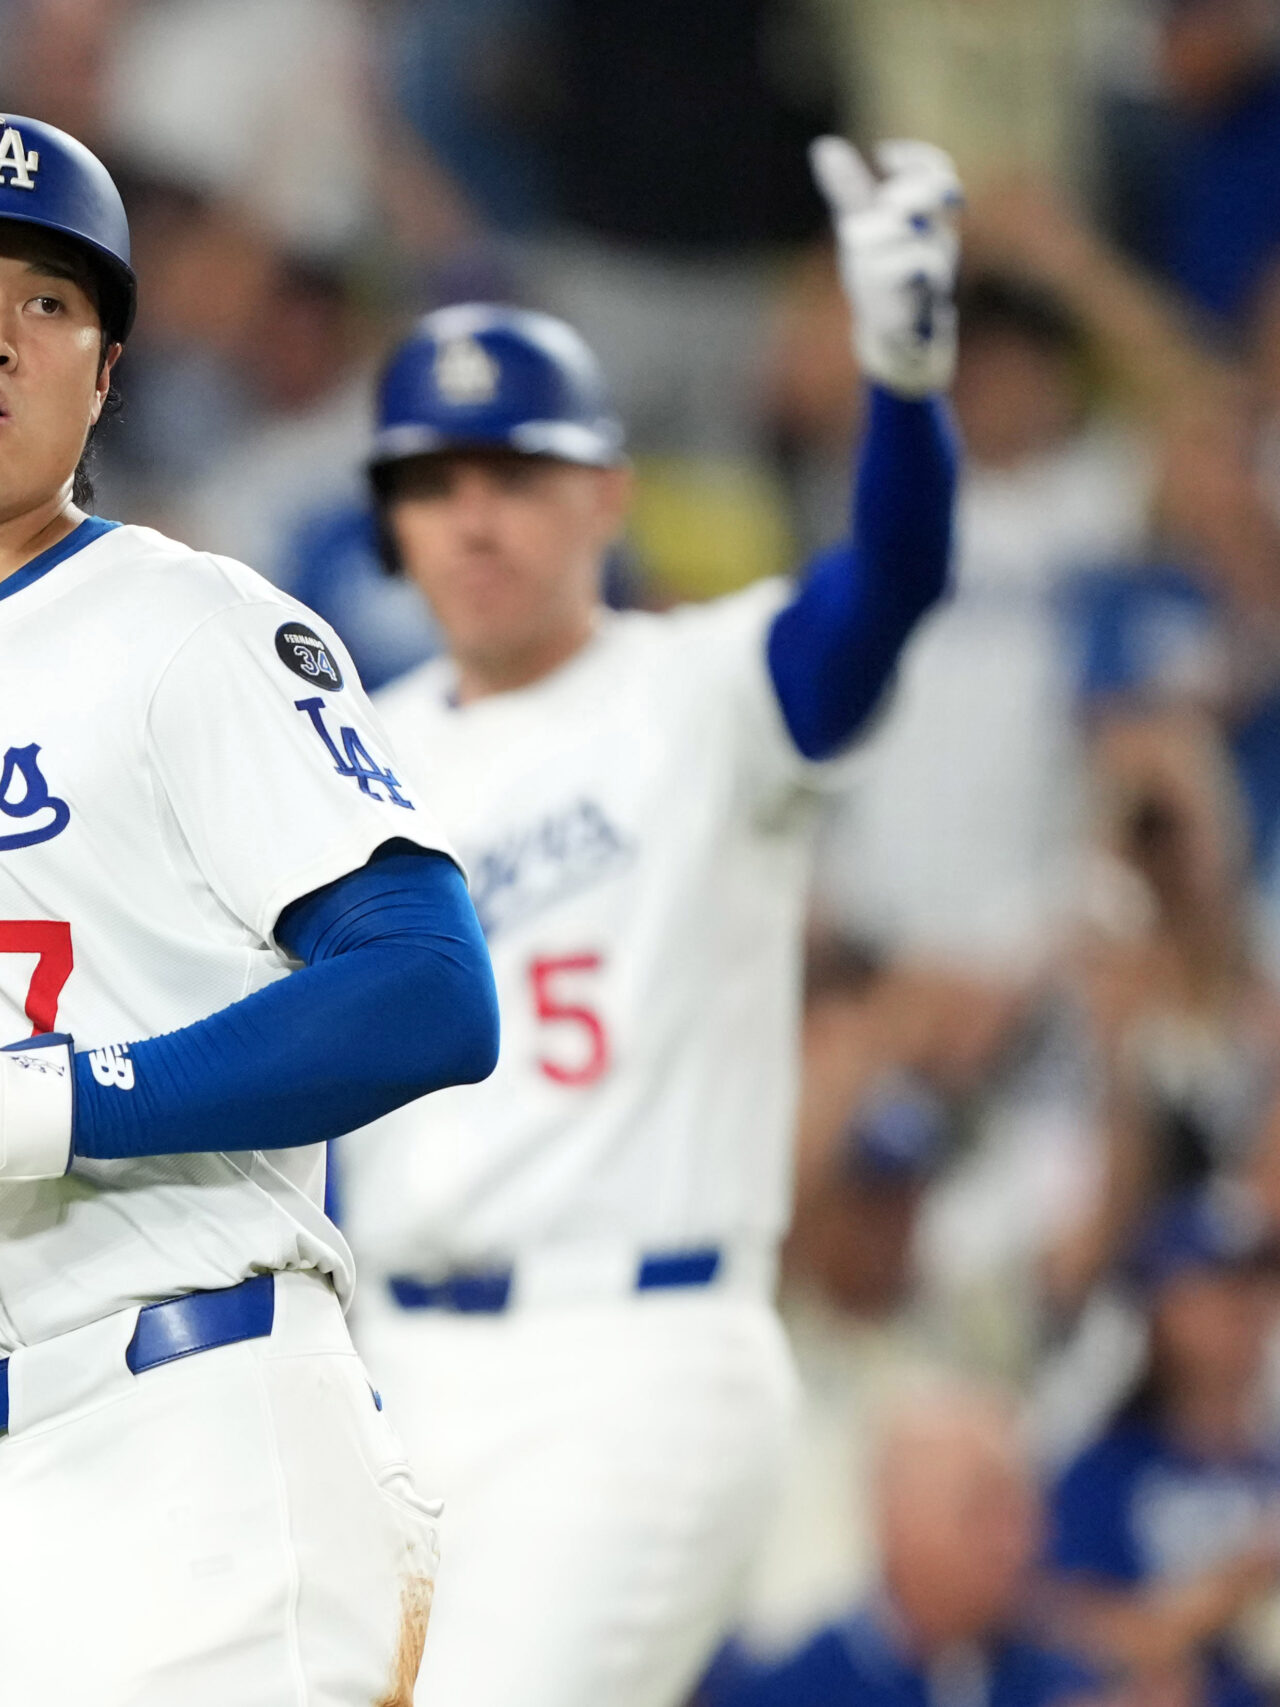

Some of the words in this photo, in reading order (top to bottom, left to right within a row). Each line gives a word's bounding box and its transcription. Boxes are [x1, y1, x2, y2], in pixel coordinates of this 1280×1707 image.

[292, 645, 338, 682] 34
[293, 696, 417, 811] LA
[526, 951, 610, 1088] 5
